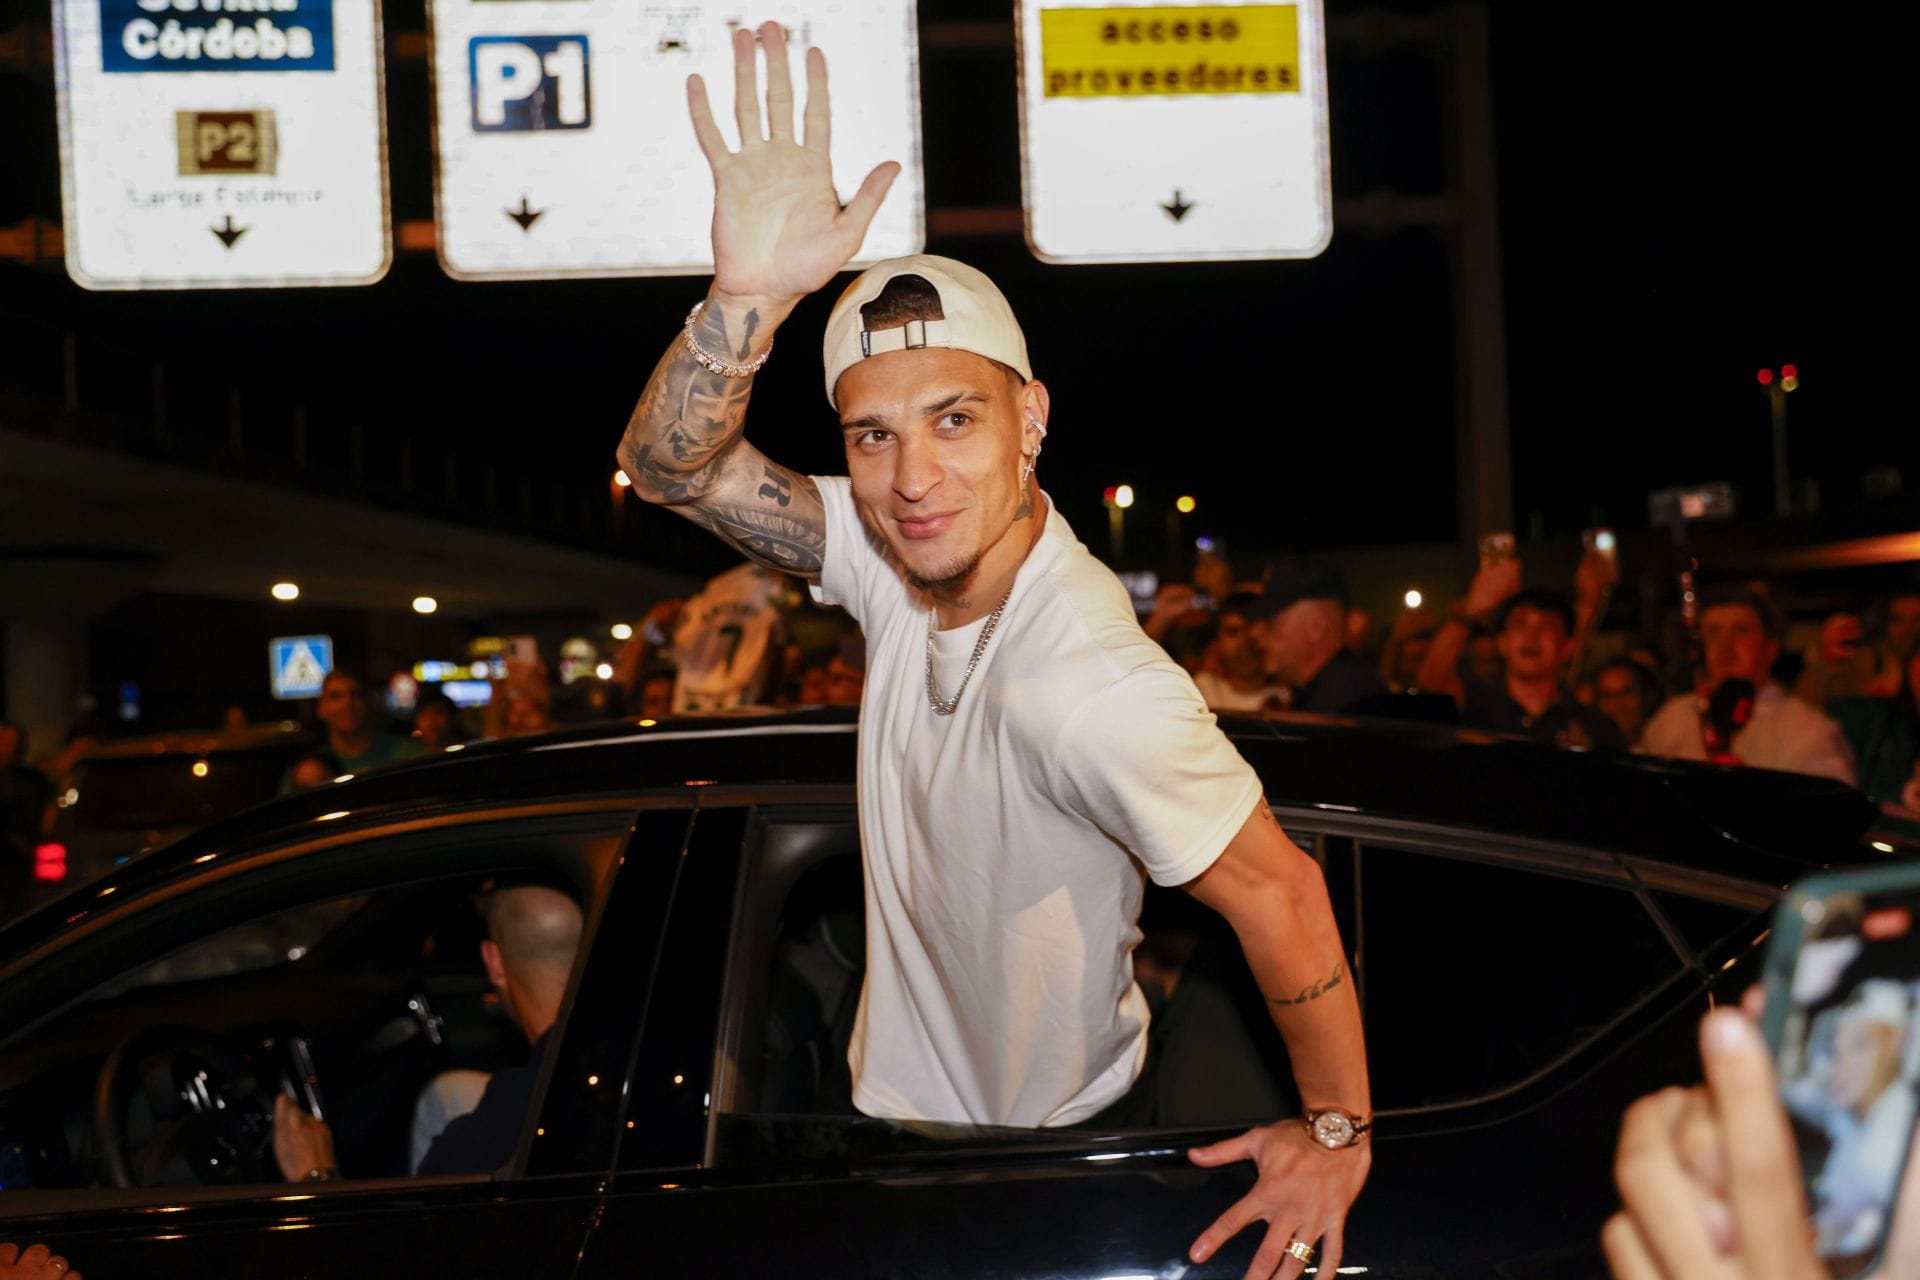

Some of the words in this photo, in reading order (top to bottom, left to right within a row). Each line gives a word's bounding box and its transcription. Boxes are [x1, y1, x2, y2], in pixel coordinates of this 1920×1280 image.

[122, 17, 315, 60] Córdoba
[1102, 19, 1240, 44] acceso
[475, 41, 586, 126] P1
[1050, 59, 1293, 93] proveedores
[200, 121, 254, 161] P2
[720, 625, 744, 672] 7
